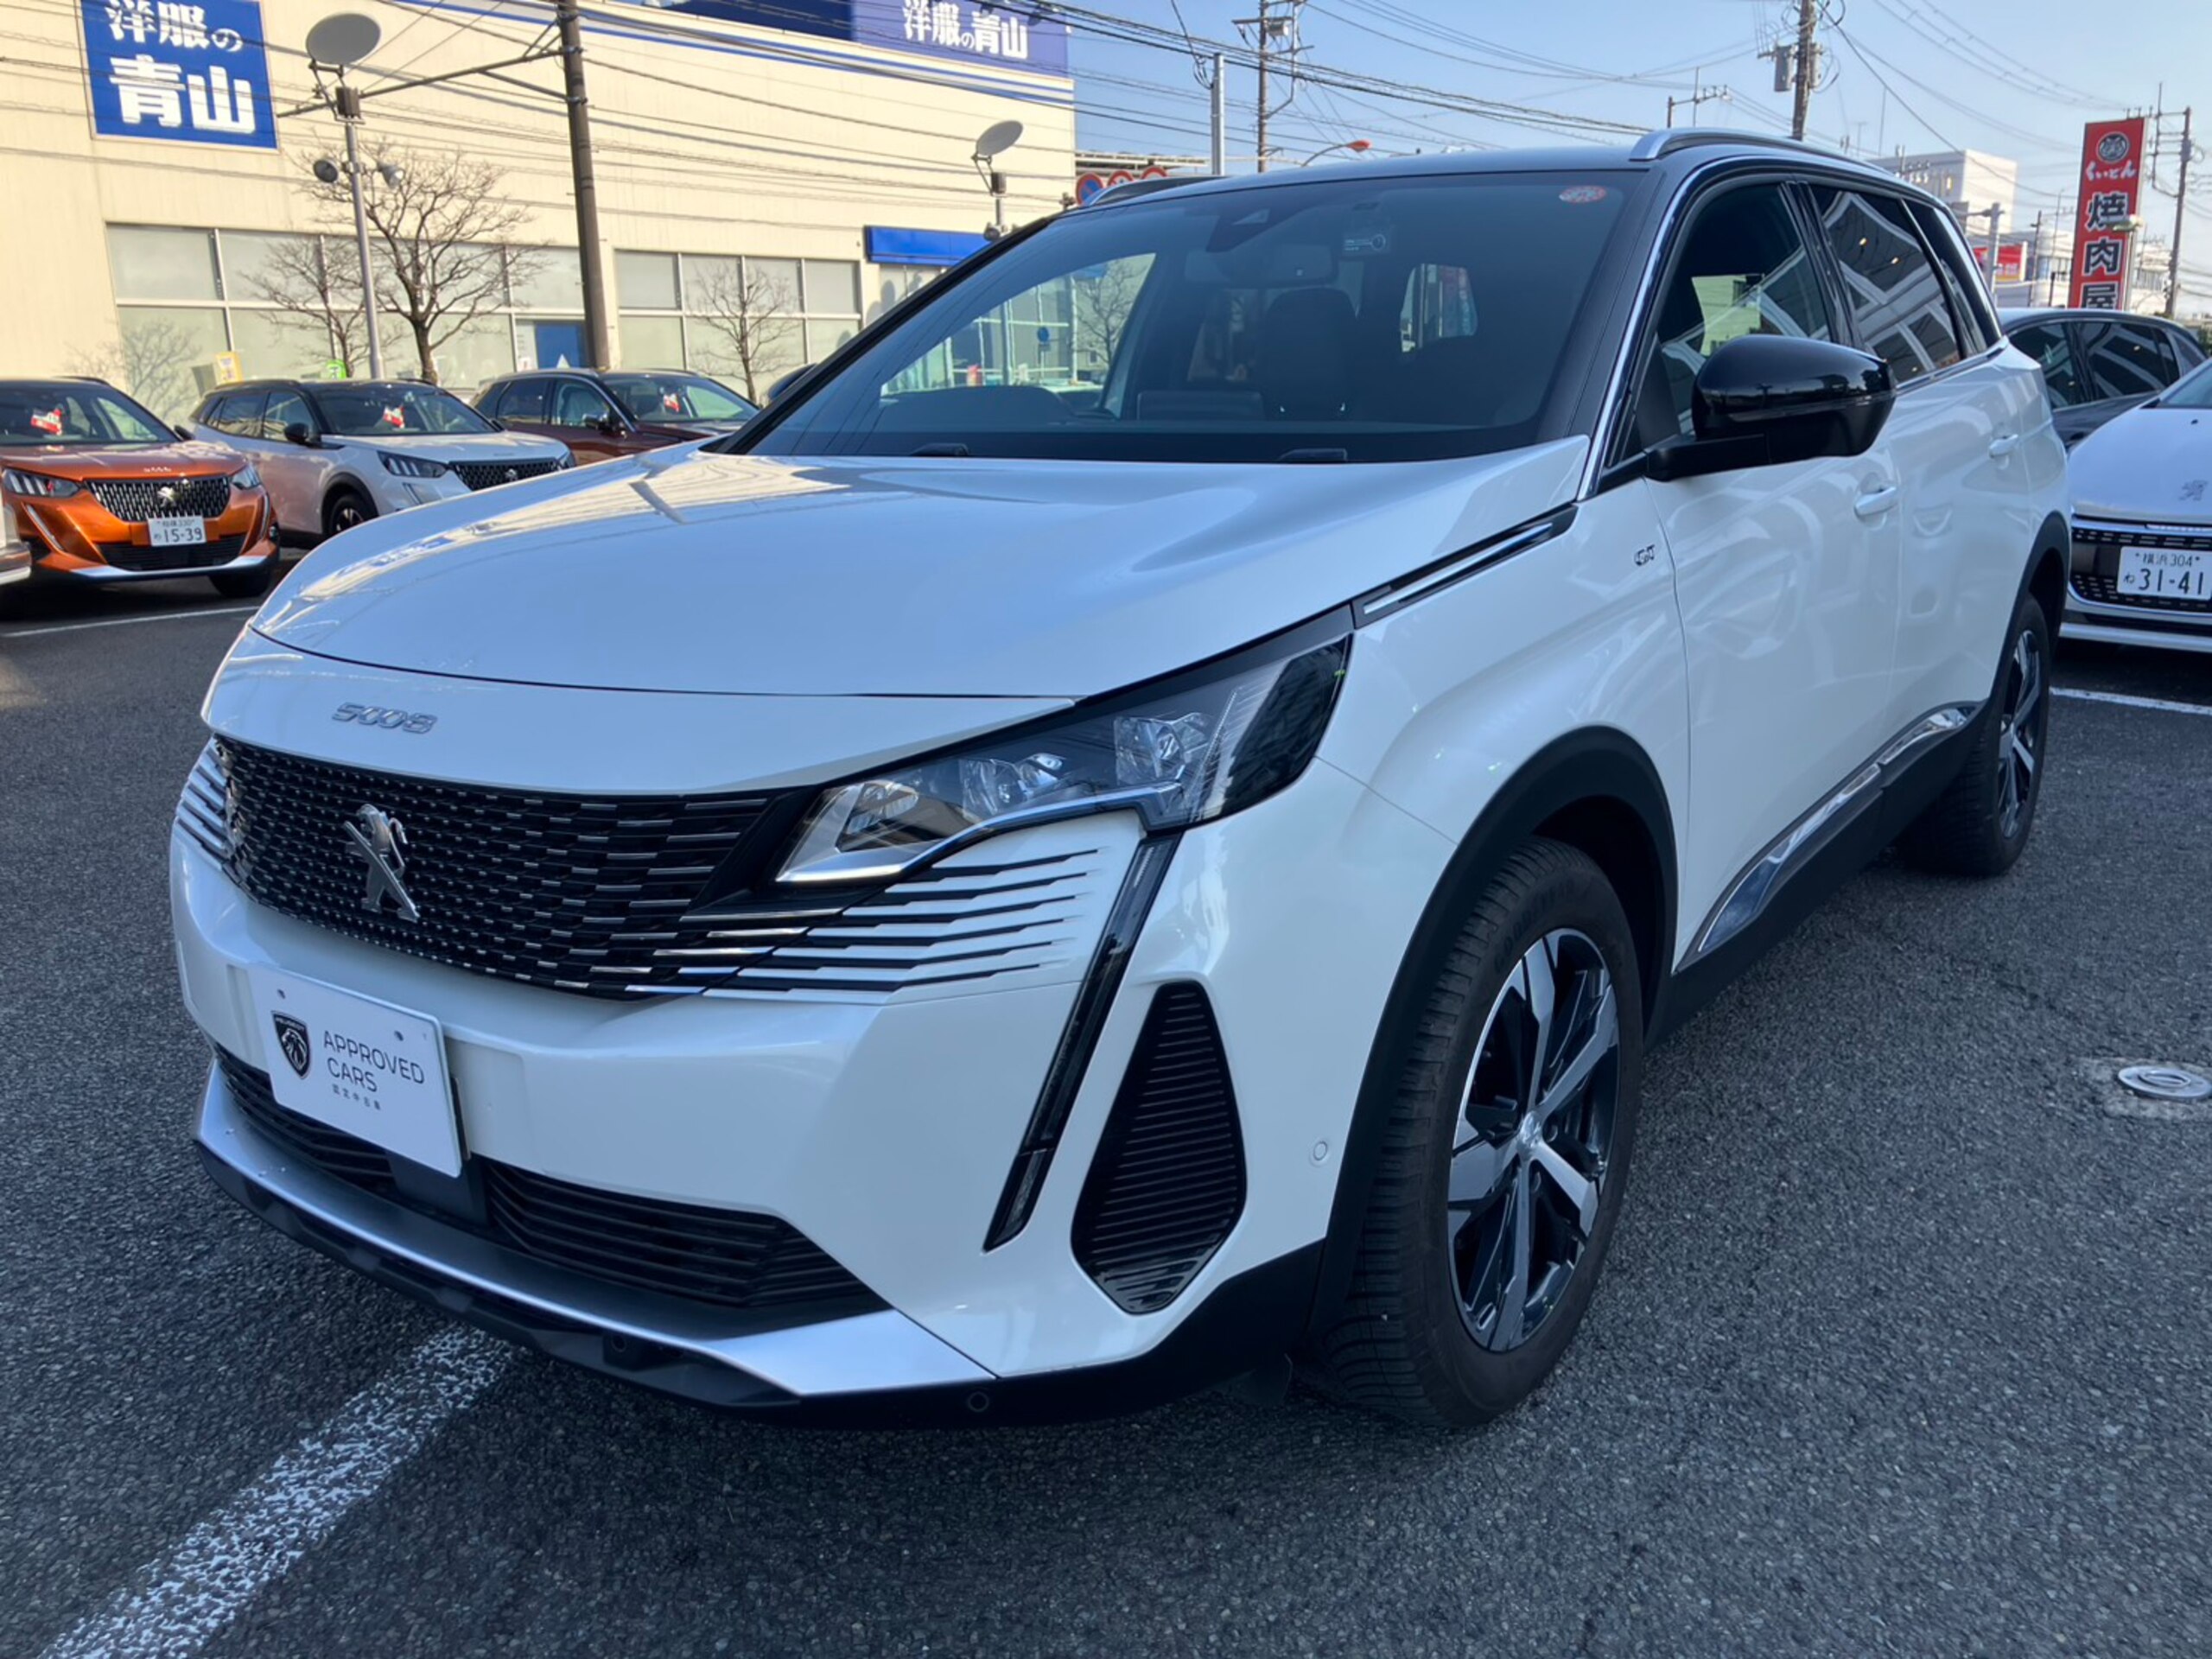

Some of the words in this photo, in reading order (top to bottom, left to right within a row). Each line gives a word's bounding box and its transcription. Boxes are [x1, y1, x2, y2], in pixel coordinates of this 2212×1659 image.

[104, 0, 244, 52] 洋服の
[902, 0, 1028, 60] 洋服の青山
[109, 54, 256, 134] 青山
[2081, 190, 2128, 310] 焼肉屋
[164, 527, 203, 543] 15-39
[1633, 544, 1656, 567] GT
[2138, 568, 2203, 595] 31-41
[332, 702, 438, 734] 5008
[323, 1030, 426, 1085] APPROVED
[327, 1057, 378, 1102] CARS
